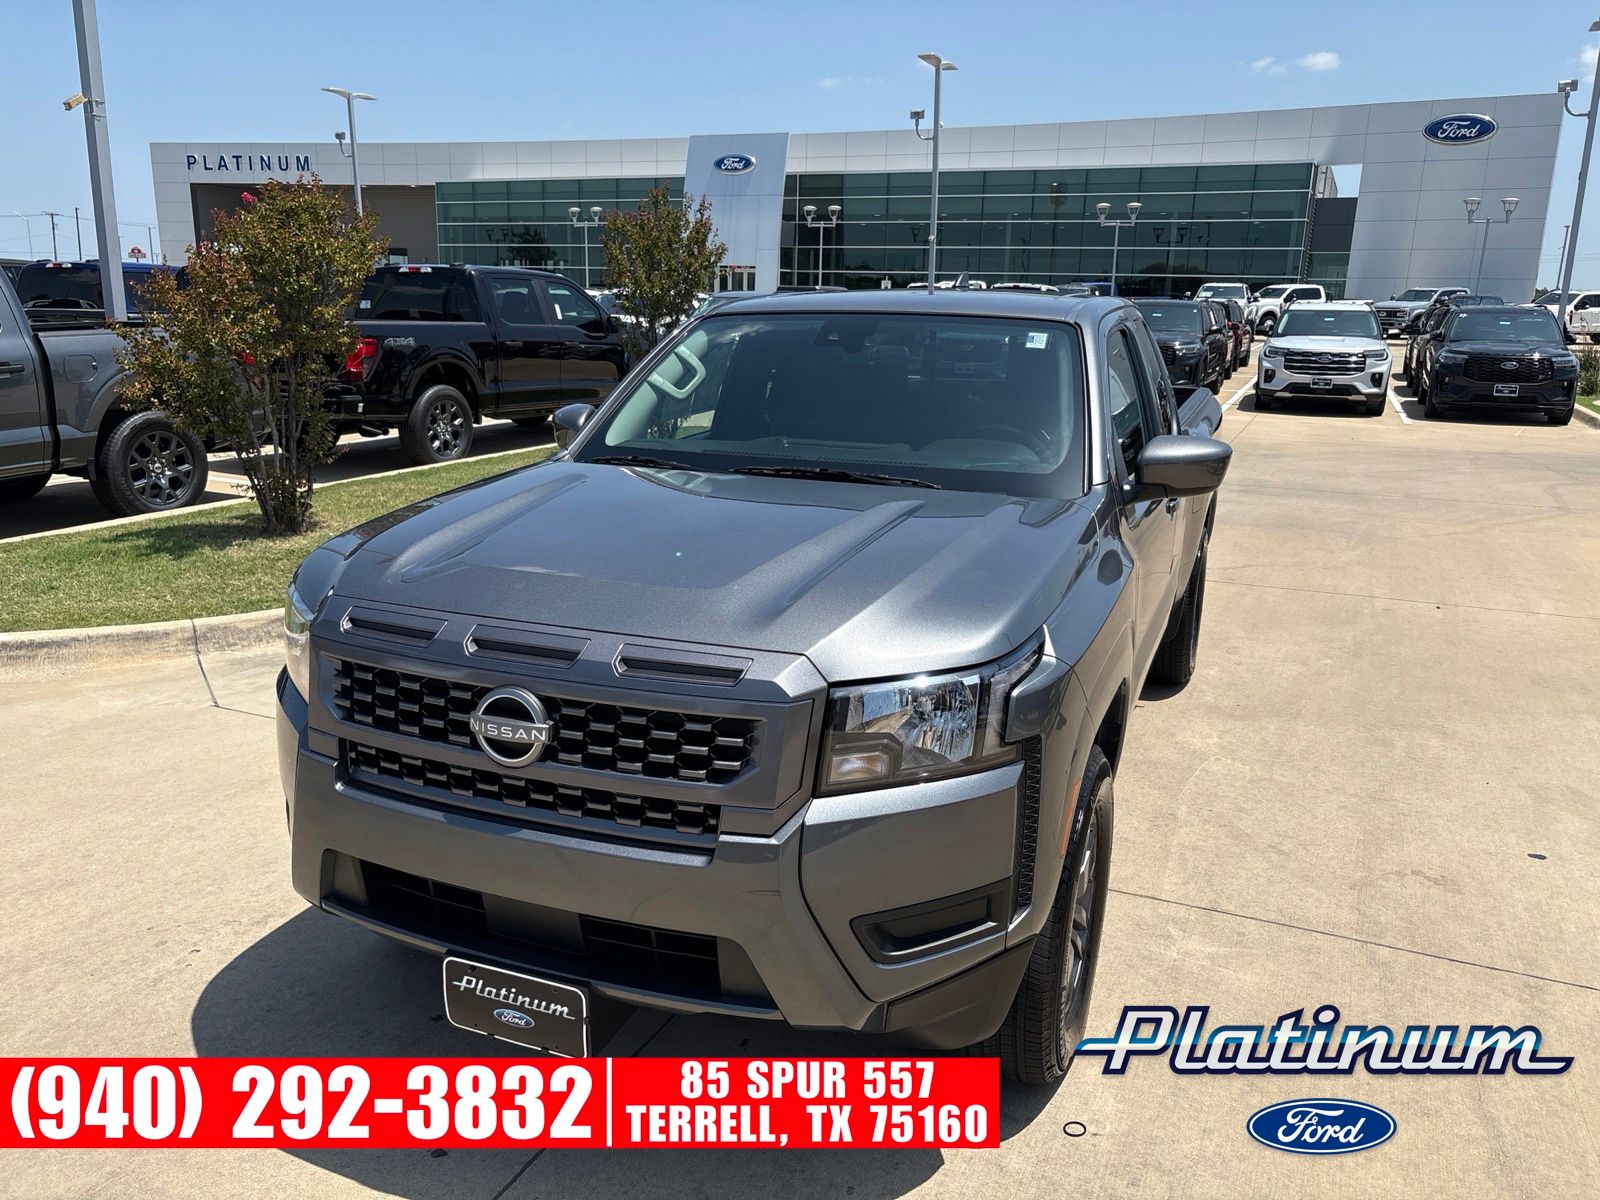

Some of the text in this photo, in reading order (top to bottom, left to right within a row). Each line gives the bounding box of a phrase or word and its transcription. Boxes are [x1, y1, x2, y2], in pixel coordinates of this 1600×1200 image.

[1438, 121, 1480, 138] Ford
[186, 155, 310, 171] PLATINUM
[721, 158, 745, 169] Ford
[470, 718, 546, 741] NISSAN
[452, 975, 576, 1020] Platinum
[501, 1009, 527, 1026] Ford
